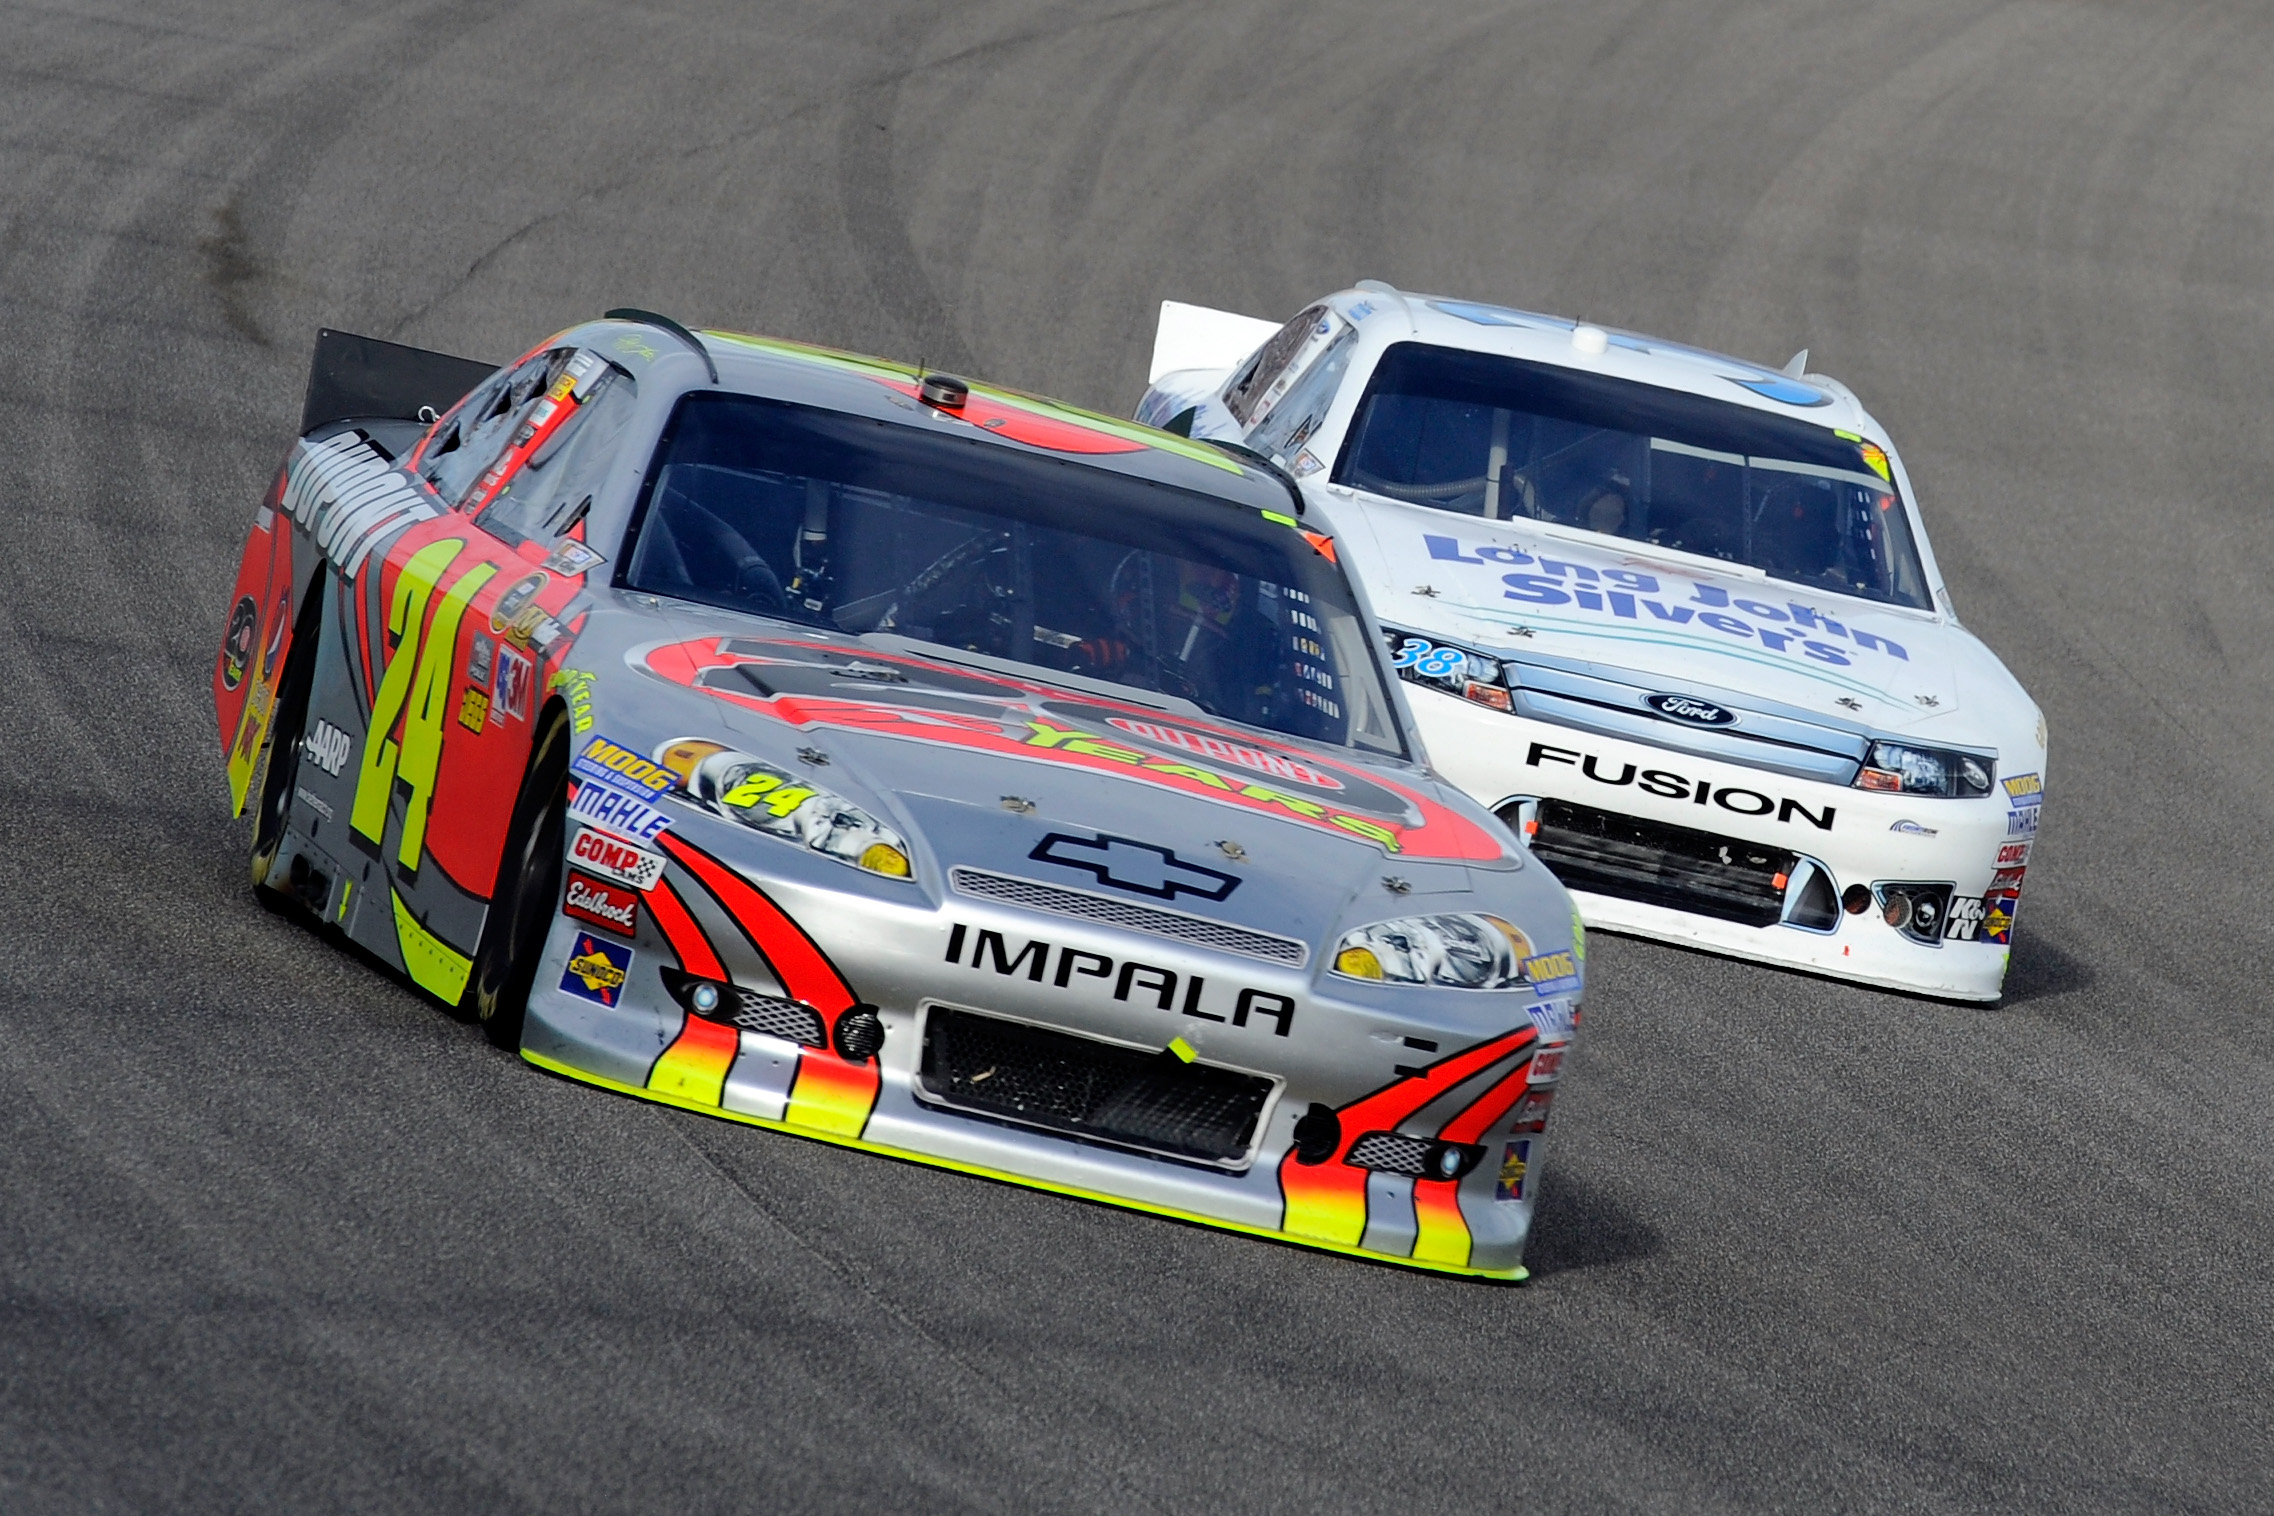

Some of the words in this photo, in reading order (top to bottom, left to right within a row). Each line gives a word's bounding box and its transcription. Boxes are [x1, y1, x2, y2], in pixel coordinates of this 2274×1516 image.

[1423, 534, 1659, 592] Long
[1690, 583, 1909, 661] John
[1503, 571, 1851, 667] Silver's
[1392, 638, 1468, 677] 38
[350, 537, 498, 872] 24
[1661, 694, 1718, 723] Ford
[306, 718, 352, 778] AARP
[581, 739, 677, 791] MOOG
[572, 781, 671, 839] MAHLE
[722, 772, 818, 818] 24
[1024, 720, 1403, 854] YEARS
[1526, 742, 1836, 831] FUSION
[2004, 774, 2041, 797] MOOG
[574, 833, 639, 870] COMP
[611, 866, 645, 885] CAMS
[566, 881, 635, 927] Edelbrock
[945, 922, 1296, 1038] IMPALA
[1525, 951, 1576, 984] MOOG
